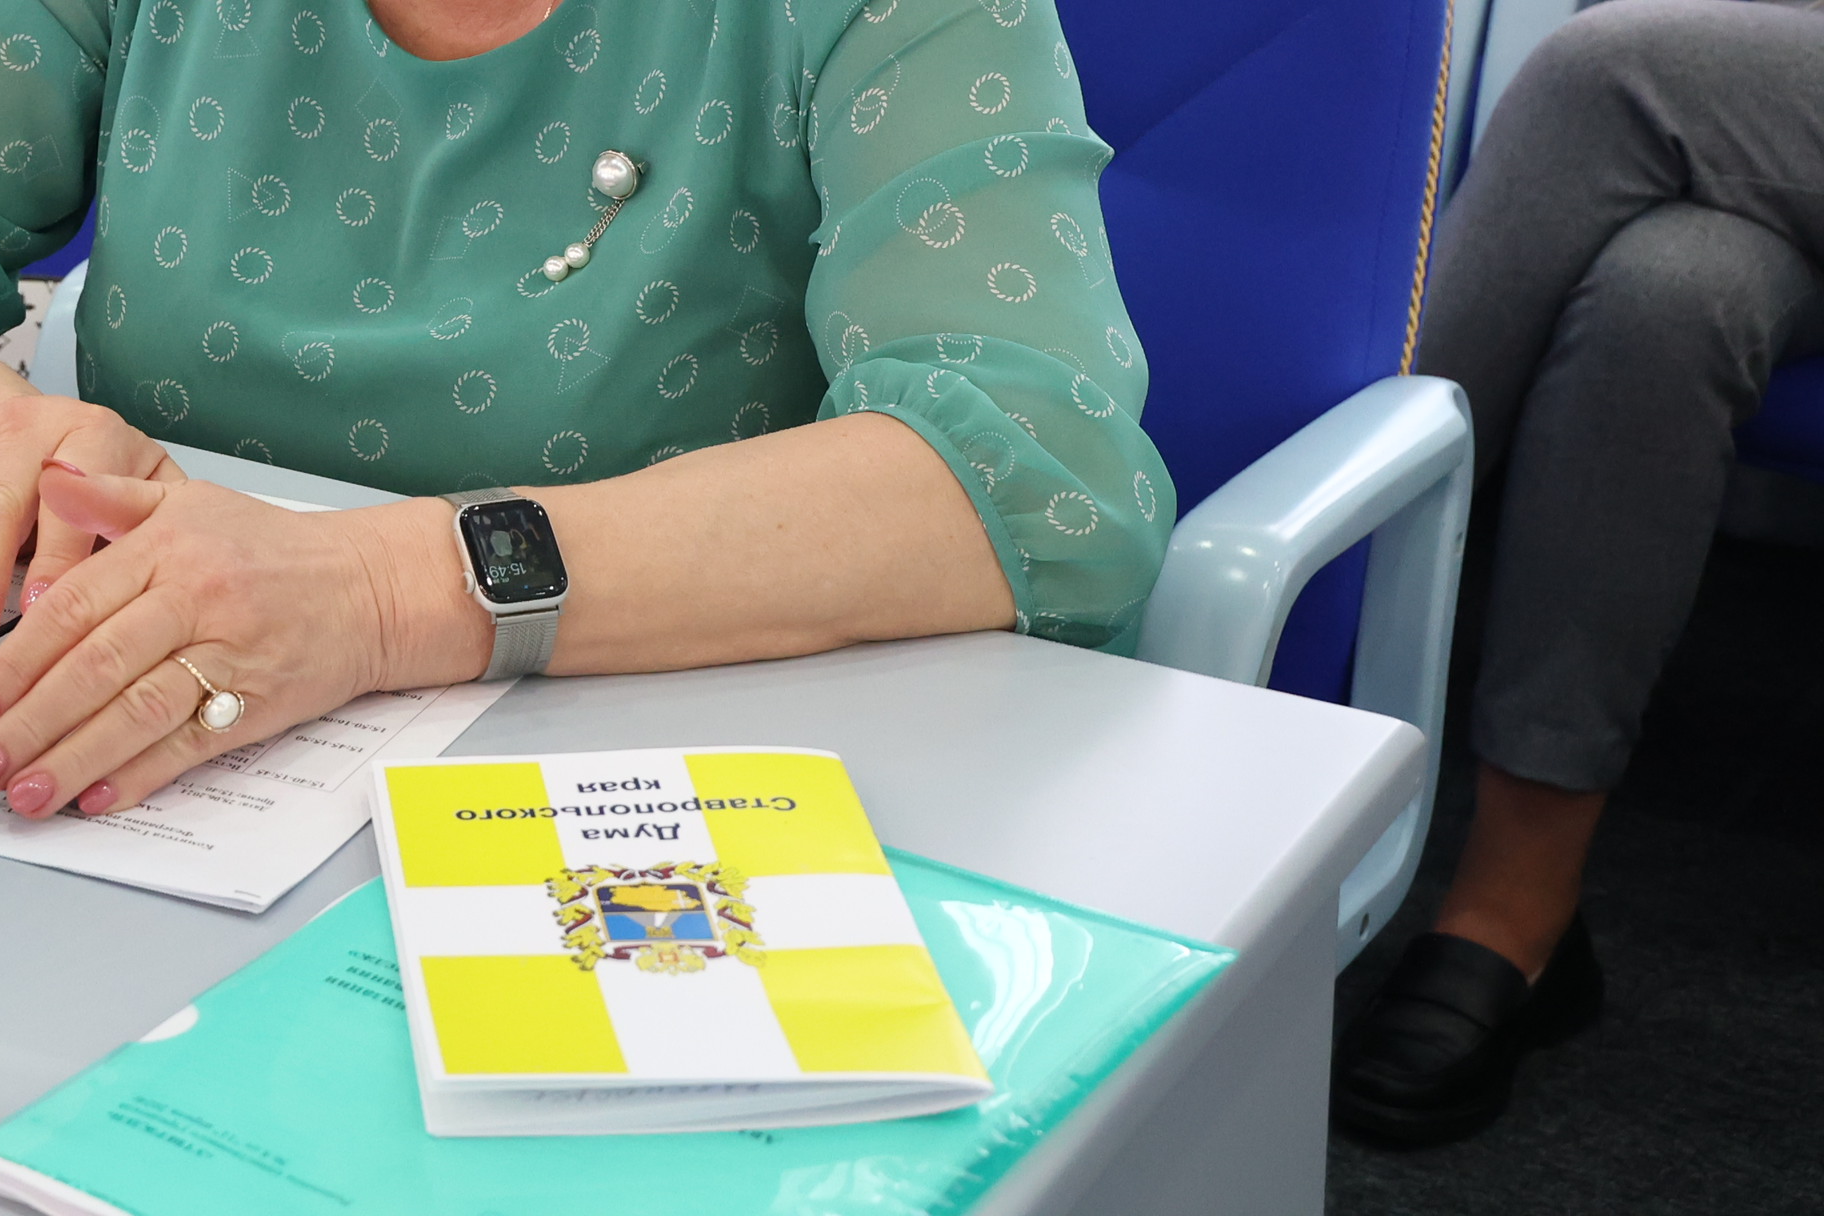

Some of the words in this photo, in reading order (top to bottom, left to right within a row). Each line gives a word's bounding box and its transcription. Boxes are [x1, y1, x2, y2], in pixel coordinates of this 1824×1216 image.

[489, 563, 526, 578] 15:49
[317, 715, 388, 734] 15:50-16:00
[294, 735, 364, 754] 15:45-15:50
[257, 768, 326, 789] 15:40-15:45
[576, 776, 662, 796] края
[455, 795, 797, 822] Ставропольского
[580, 822, 682, 843] Дума
